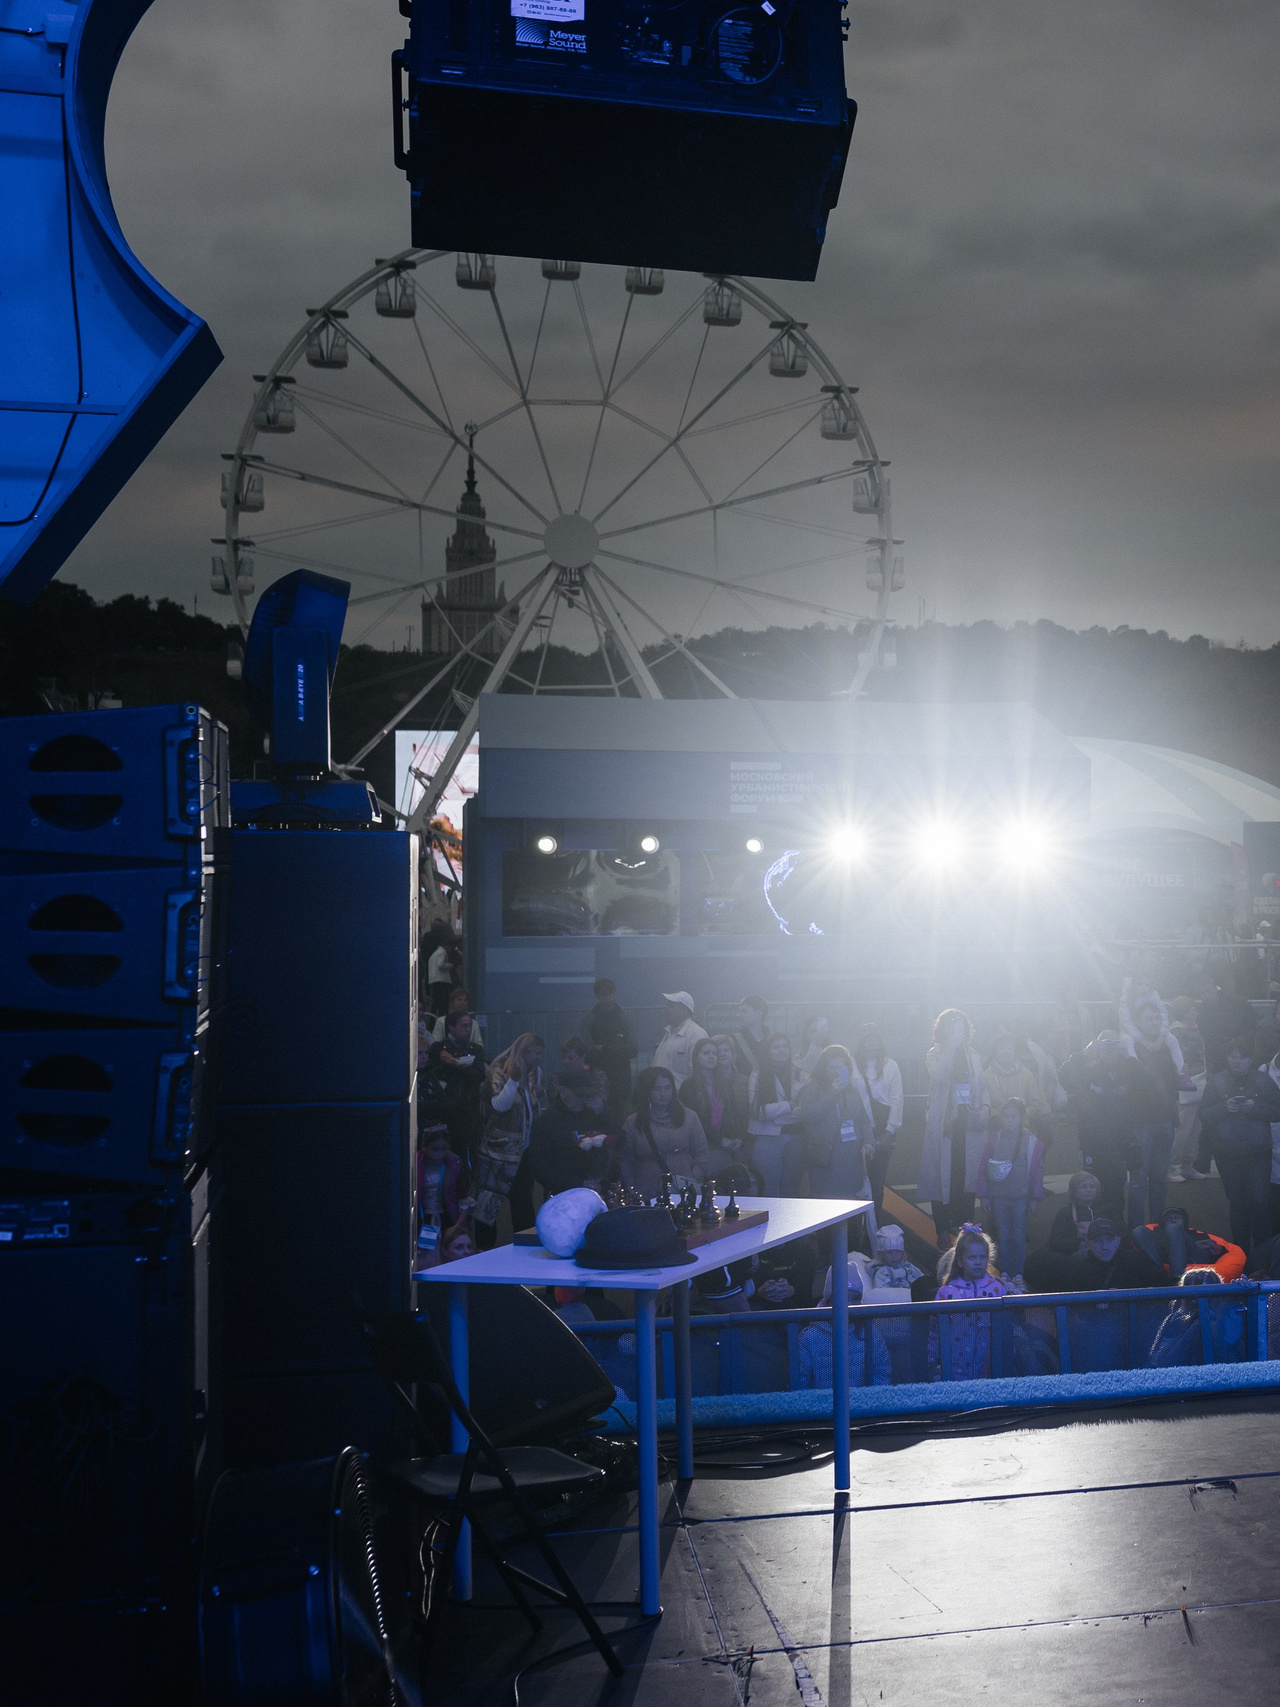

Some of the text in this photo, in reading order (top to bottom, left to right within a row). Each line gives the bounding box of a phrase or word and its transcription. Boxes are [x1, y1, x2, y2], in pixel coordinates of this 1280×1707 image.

[549, 30, 587, 42] Meyer
[549, 38, 587, 50] Sound
[730, 771, 814, 782] МОСКОВСКИЙ
[730, 794, 775, 803] ФОРУМ
[1104, 873, 1186, 889] БУДУЩЕЕ
